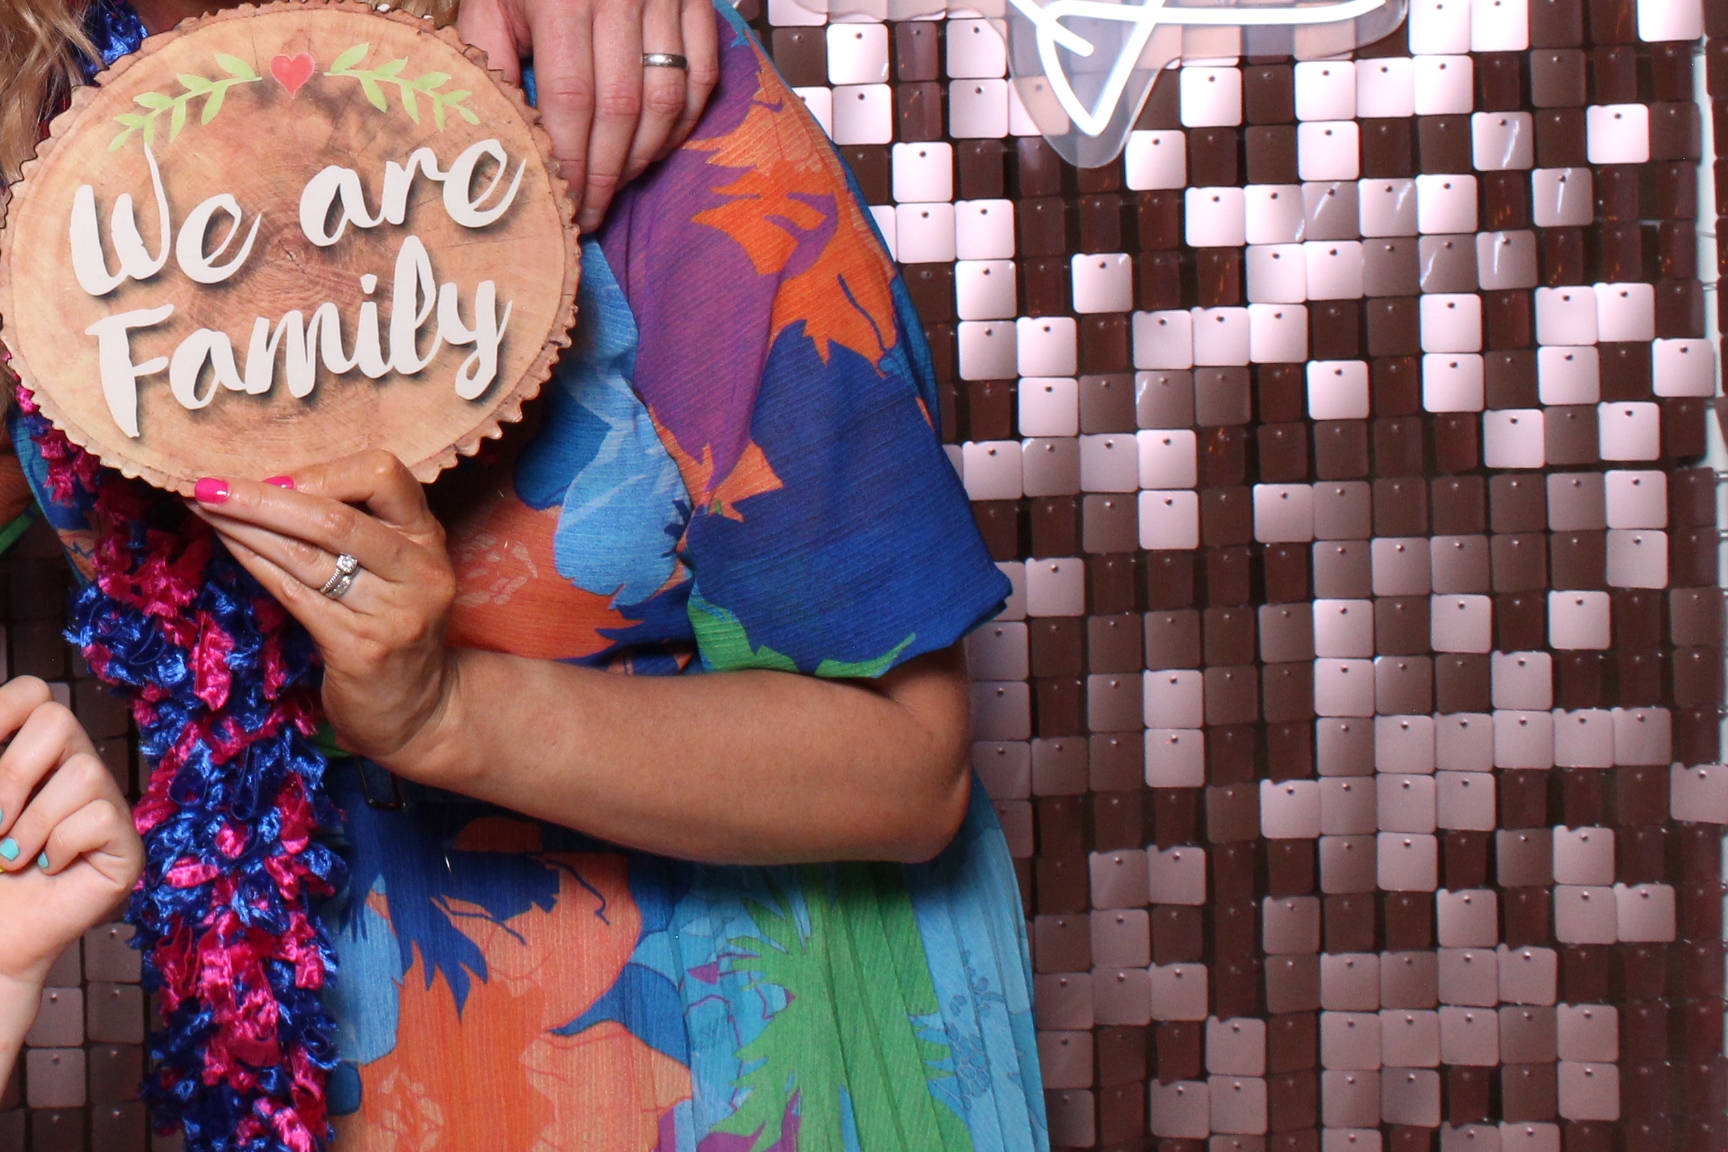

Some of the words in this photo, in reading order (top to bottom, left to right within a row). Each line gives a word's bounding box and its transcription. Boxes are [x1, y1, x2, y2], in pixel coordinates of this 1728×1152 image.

[70, 142, 262, 295] We
[299, 138, 526, 247] are
[85, 235, 512, 438] Family
